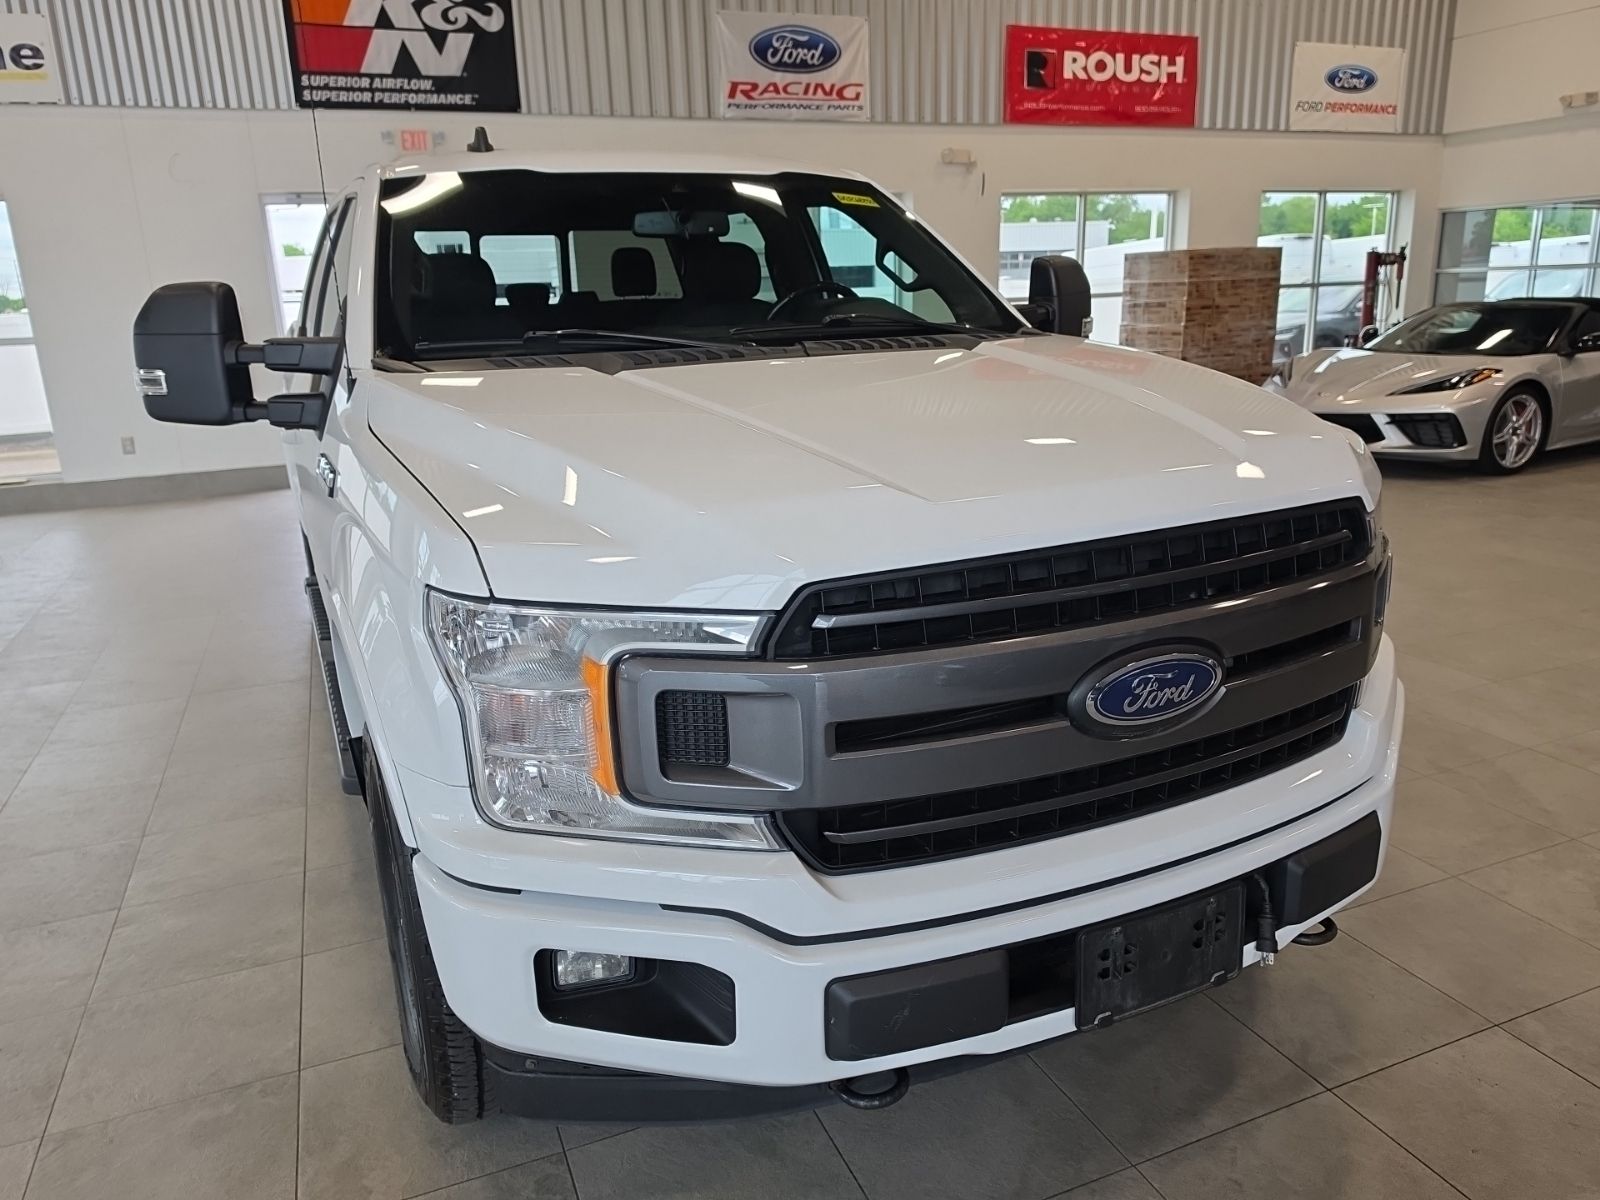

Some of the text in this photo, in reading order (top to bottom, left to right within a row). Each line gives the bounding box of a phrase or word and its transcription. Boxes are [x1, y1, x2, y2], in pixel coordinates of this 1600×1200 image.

[767, 32, 824, 66] Ford
[1063, 50, 1185, 84] ROUSH
[301, 74, 435, 91] SUPERIOR AIRFLOW.
[1334, 69, 1369, 89] Ford
[303, 89, 372, 103] SUPERIOR
[728, 80, 864, 102] RACING
[728, 102, 864, 111] PERFORMANCE PARTS
[1295, 101, 1398, 115] FORD PERFORMANCE
[401, 129, 427, 151] EXIT
[1123, 670, 1195, 713] Ford
